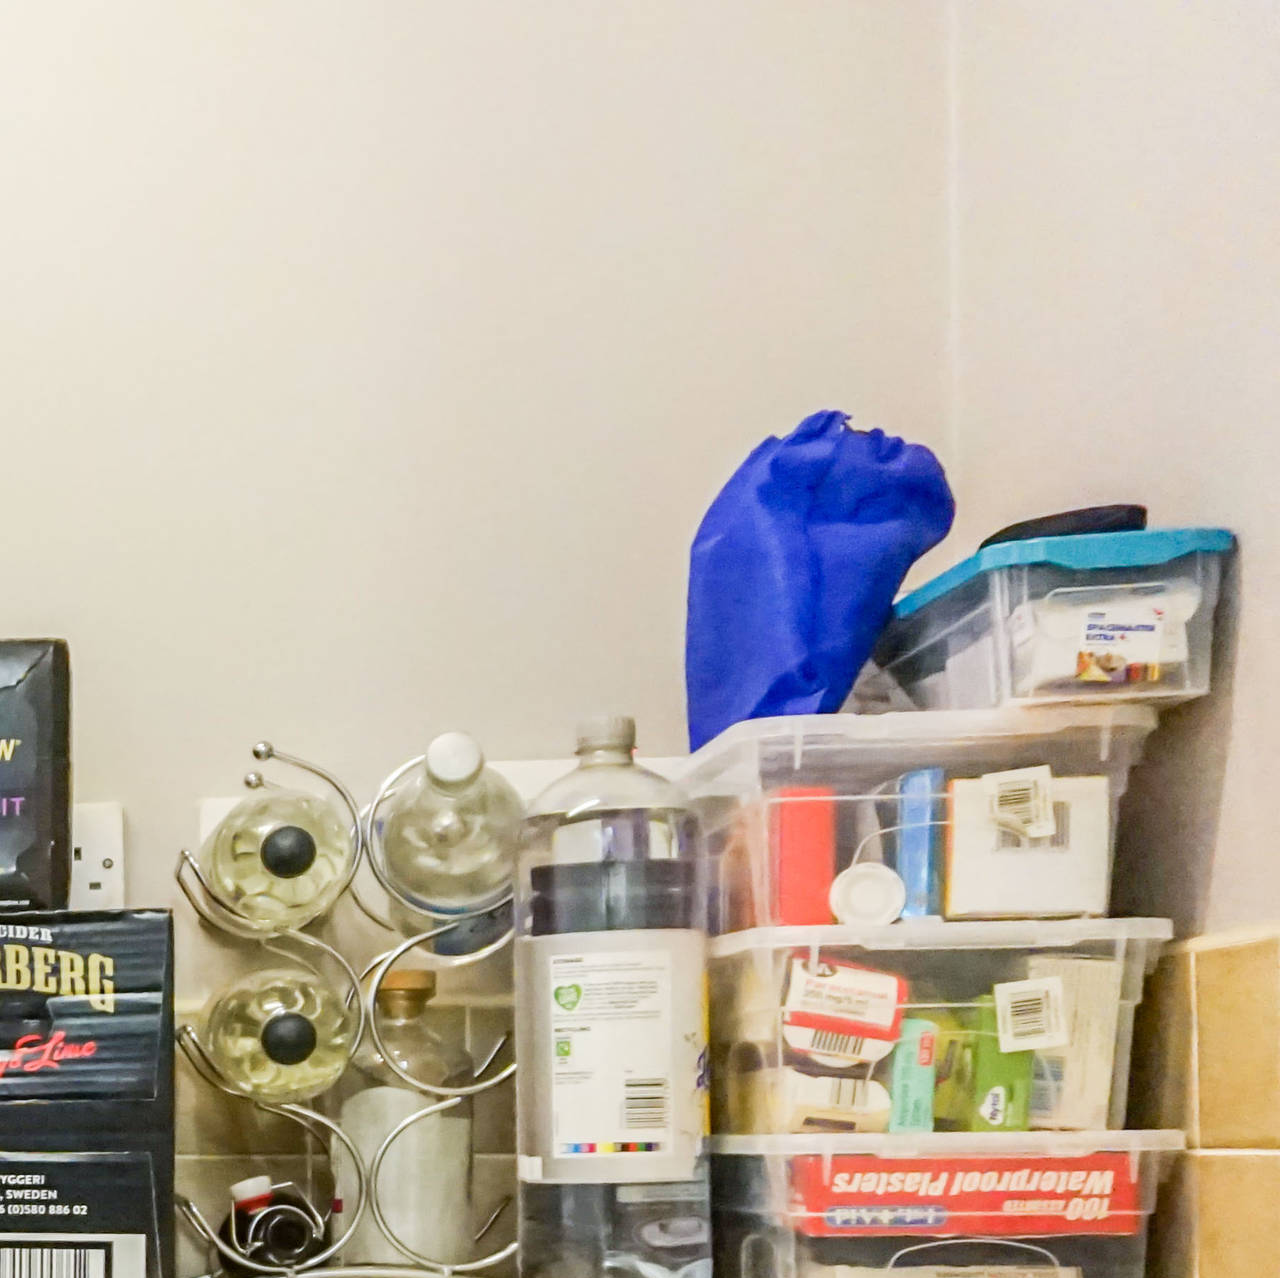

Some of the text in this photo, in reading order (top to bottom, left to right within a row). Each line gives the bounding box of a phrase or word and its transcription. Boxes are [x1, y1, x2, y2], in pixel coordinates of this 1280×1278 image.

[832, 1169, 1115, 1197] Waterproof Plasters
[6, 1190, 58, 1200] SWEDEN
[48, 1205, 70, 1215] 886
[72, 1205, 88, 1215] 02
[1065, 1197, 1111, 1221] 100
